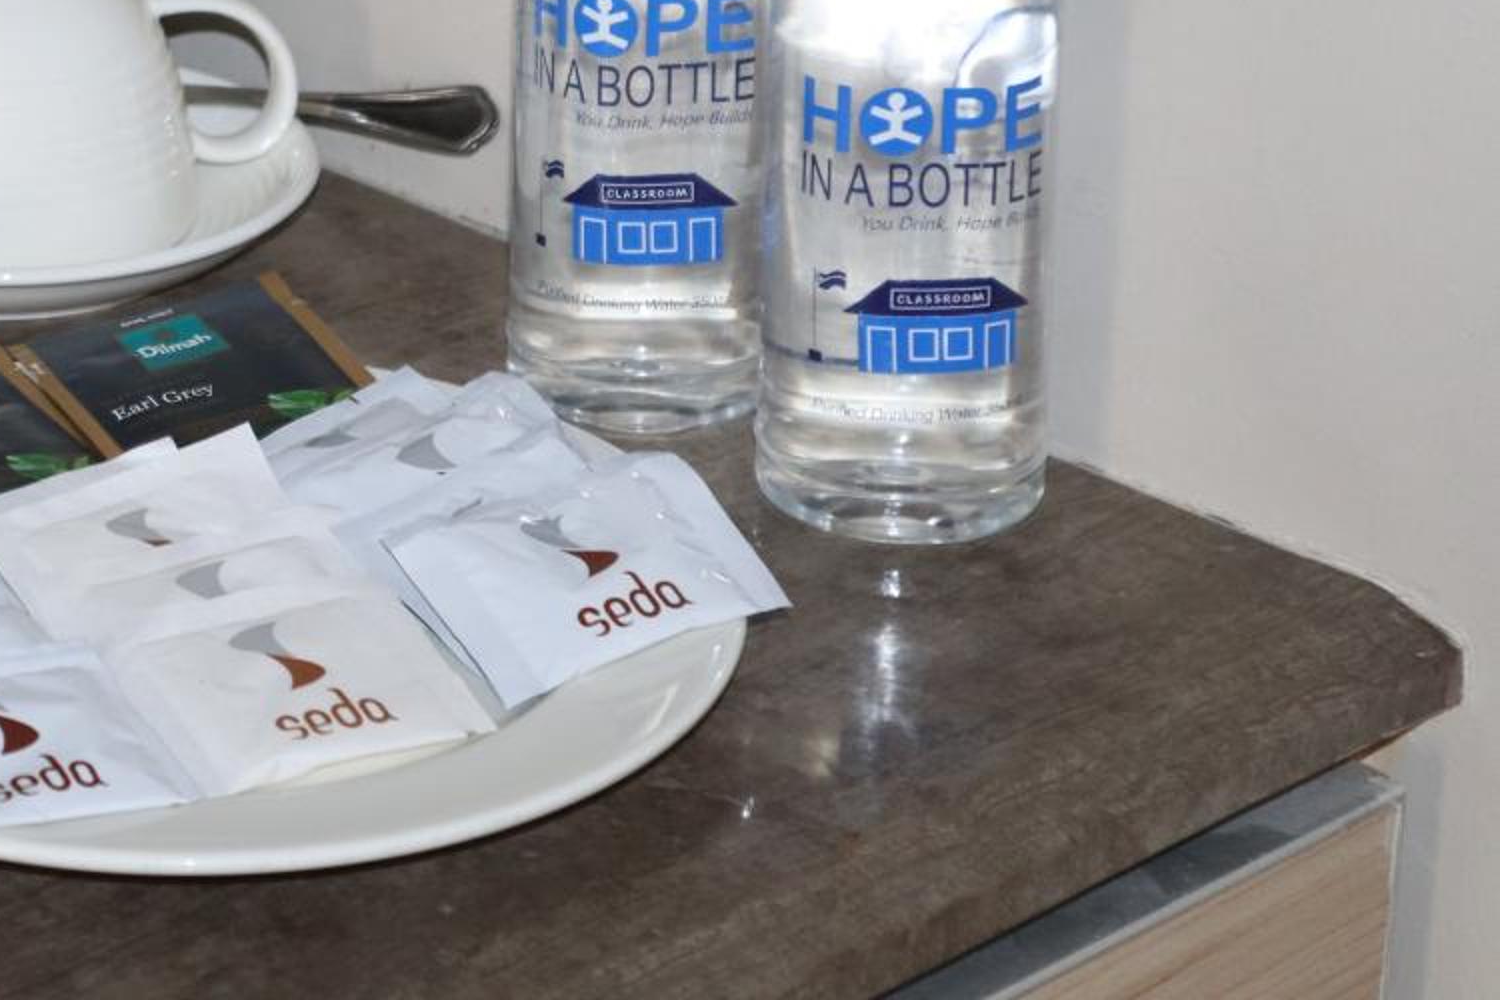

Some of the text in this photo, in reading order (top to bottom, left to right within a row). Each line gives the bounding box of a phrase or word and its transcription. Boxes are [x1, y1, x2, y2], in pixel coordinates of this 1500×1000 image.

[533, 41, 756, 108] IN A BOTTLE
[803, 74, 1043, 158] HOPE
[605, 185, 690, 200] CLASSROOM
[801, 149, 1043, 209] IN A BOTTLE
[896, 292, 986, 306] CLASSROOM
[137, 333, 213, 359] Dilmah
[111, 384, 214, 421] Earl Grey
[577, 570, 694, 637] seda
[275, 687, 399, 740] seda
